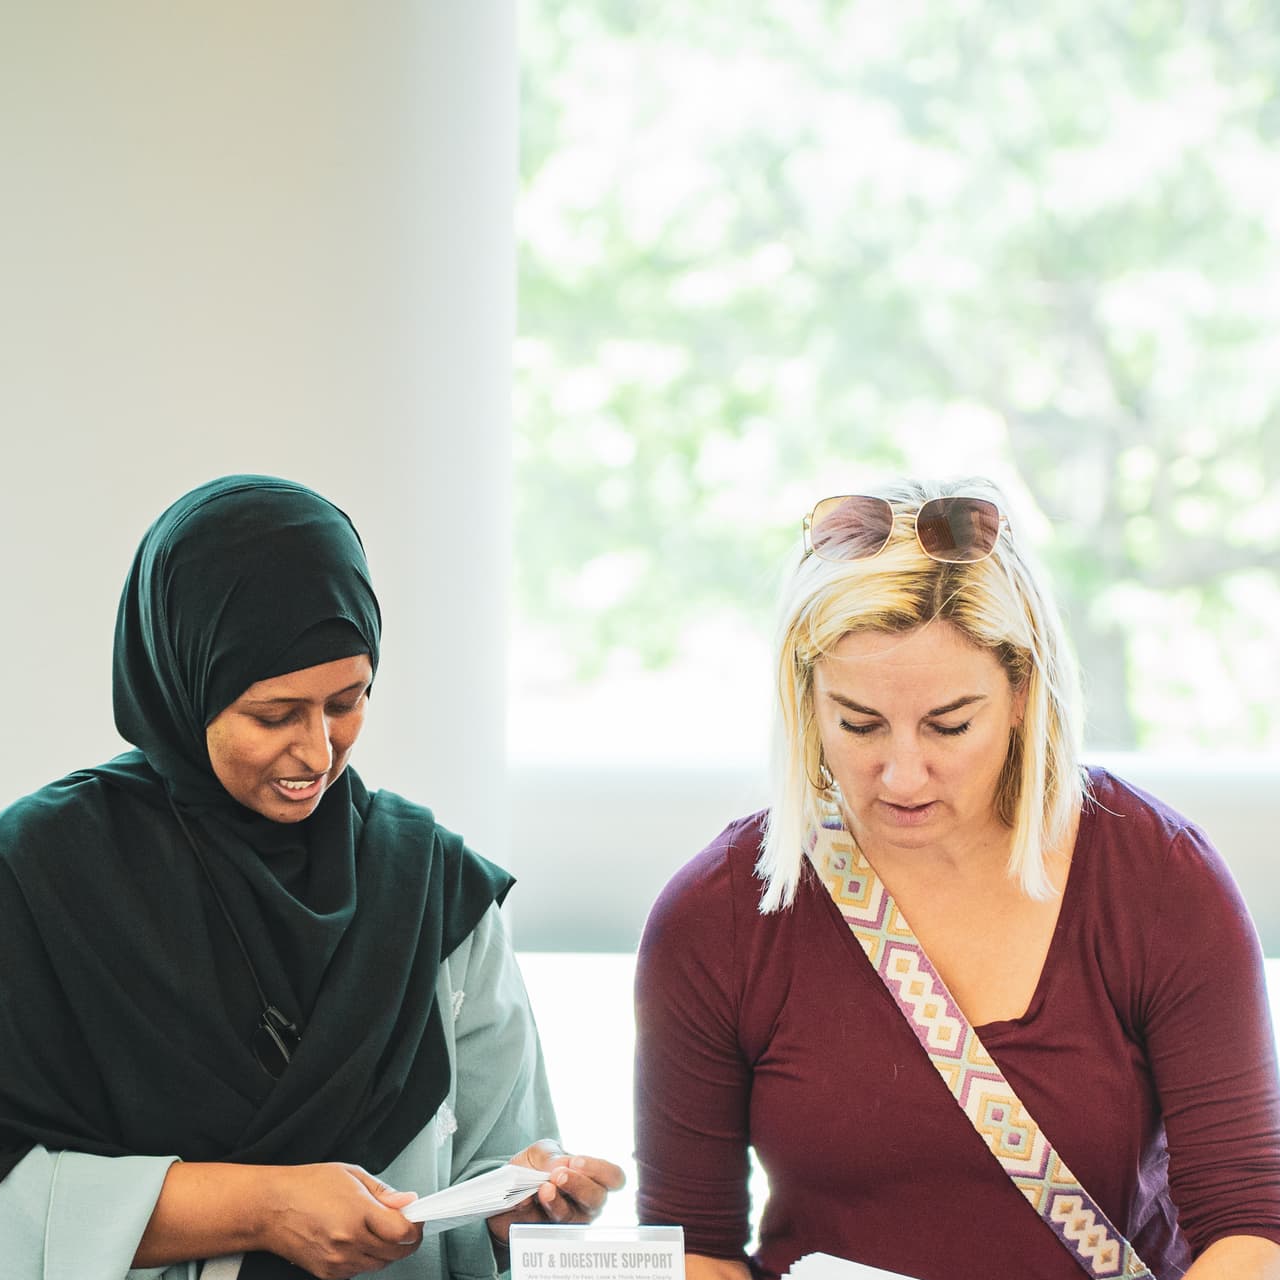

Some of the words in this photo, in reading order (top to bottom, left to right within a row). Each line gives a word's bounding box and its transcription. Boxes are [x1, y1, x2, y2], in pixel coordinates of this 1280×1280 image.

[522, 1252, 545, 1269] GUT
[547, 1253, 557, 1269] &
[560, 1252, 619, 1269] DIGESTIVE
[621, 1252, 673, 1269] SUPPORT
